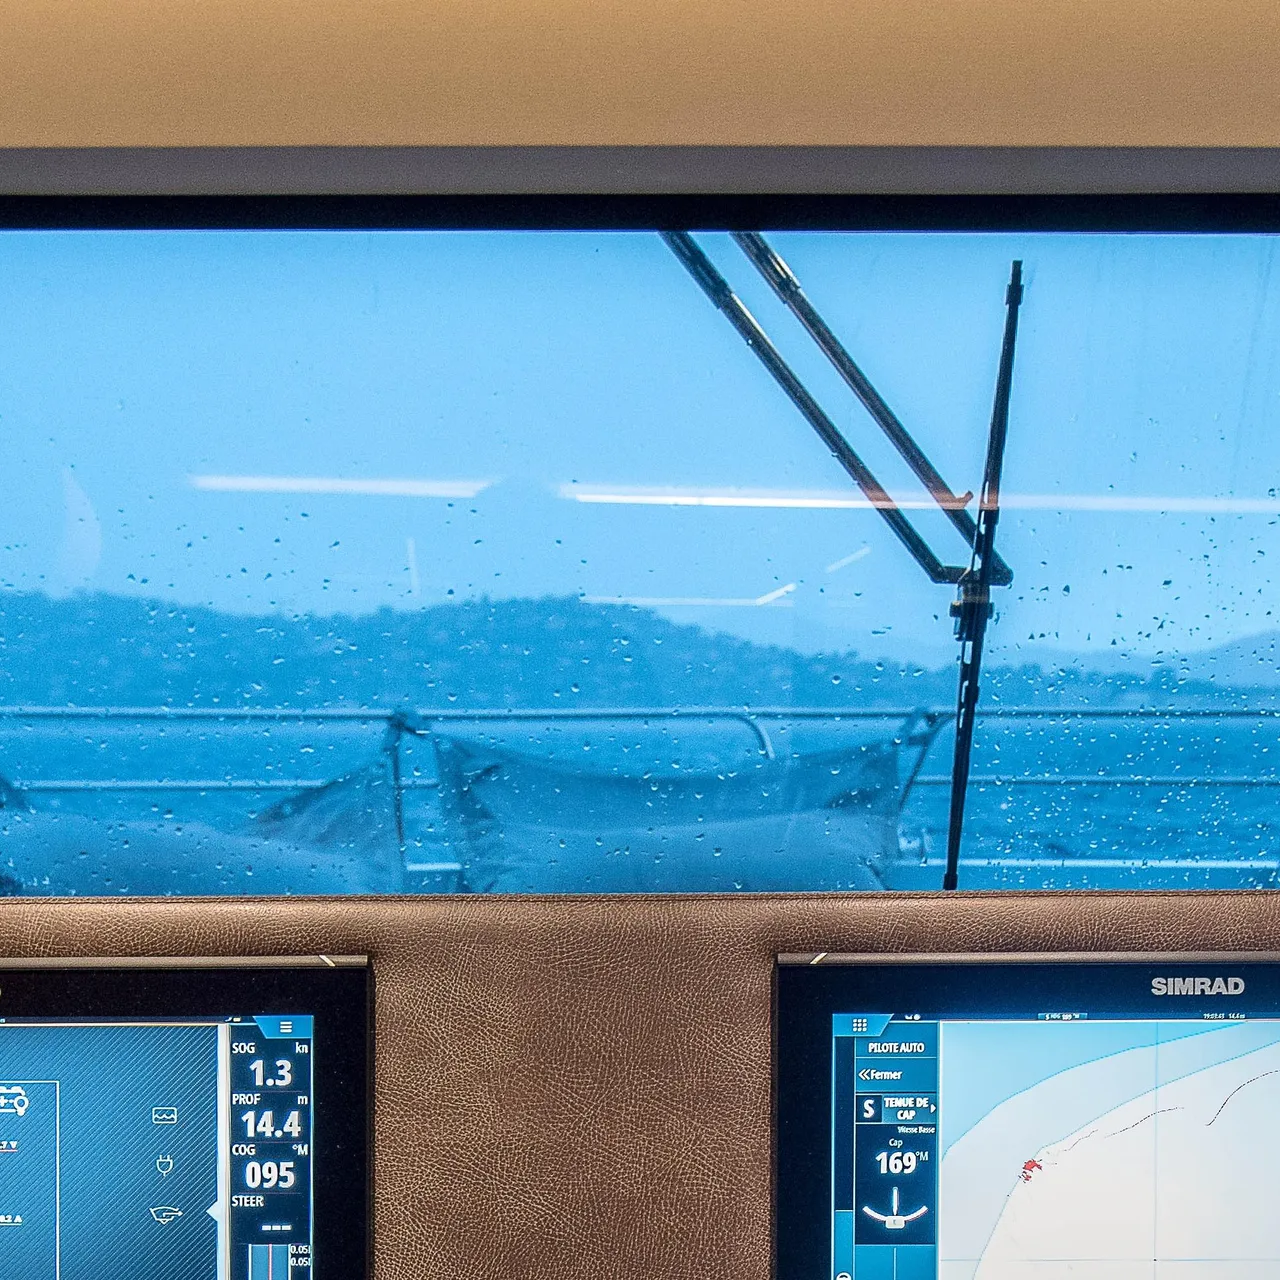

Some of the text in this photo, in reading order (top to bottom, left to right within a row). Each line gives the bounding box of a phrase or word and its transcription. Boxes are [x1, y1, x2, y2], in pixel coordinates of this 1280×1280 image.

[1151, 977, 1245, 996] SIMRAD
[232, 1042, 308, 1054] SOG kn
[868, 1043, 924, 1053] PILOTE AUTO
[249, 1059, 292, 1087] 1.3
[870, 1070, 902, 1080] Fermer
[232, 1093, 308, 1105] PROF m
[884, 1098, 928, 1108] TENUE DE
[863, 1099, 875, 1118] S
[897, 1110, 916, 1120] CAP
[241, 1110, 302, 1138] 14.4
[232, 1144, 308, 1155] COG °M
[888, 1138, 903, 1149] Cap
[875, 1151, 916, 1174] 169
[245, 1161, 295, 1189] 095
[232, 1195, 264, 1207] STEER
